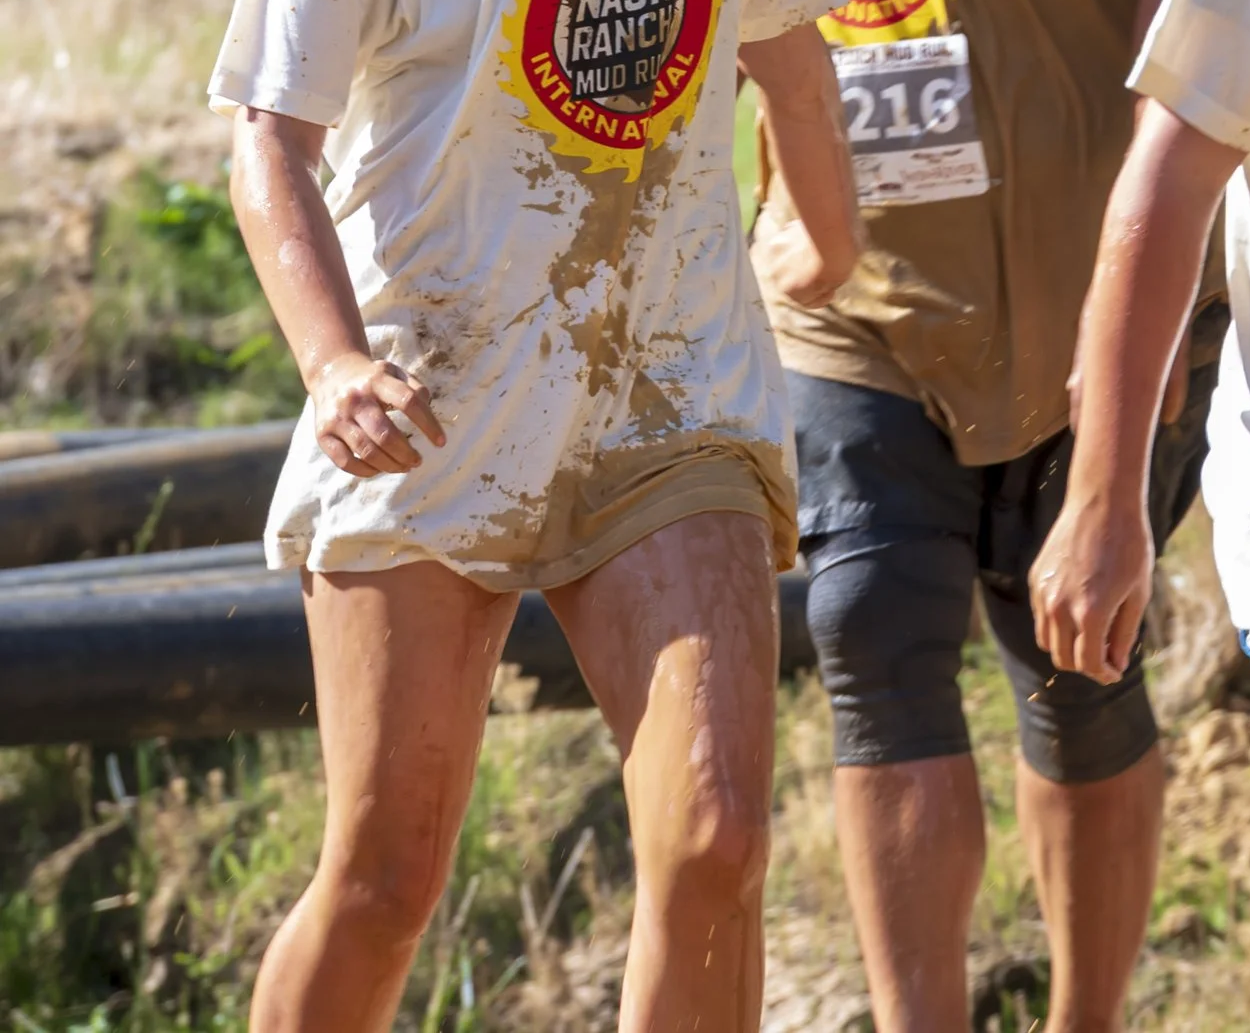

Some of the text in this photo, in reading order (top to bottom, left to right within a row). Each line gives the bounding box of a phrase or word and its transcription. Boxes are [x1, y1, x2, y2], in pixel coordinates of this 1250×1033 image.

[571, 5, 673, 62] RANCH
[575, 54, 664, 96] MUD RU
[840, 78, 961, 142] 216
